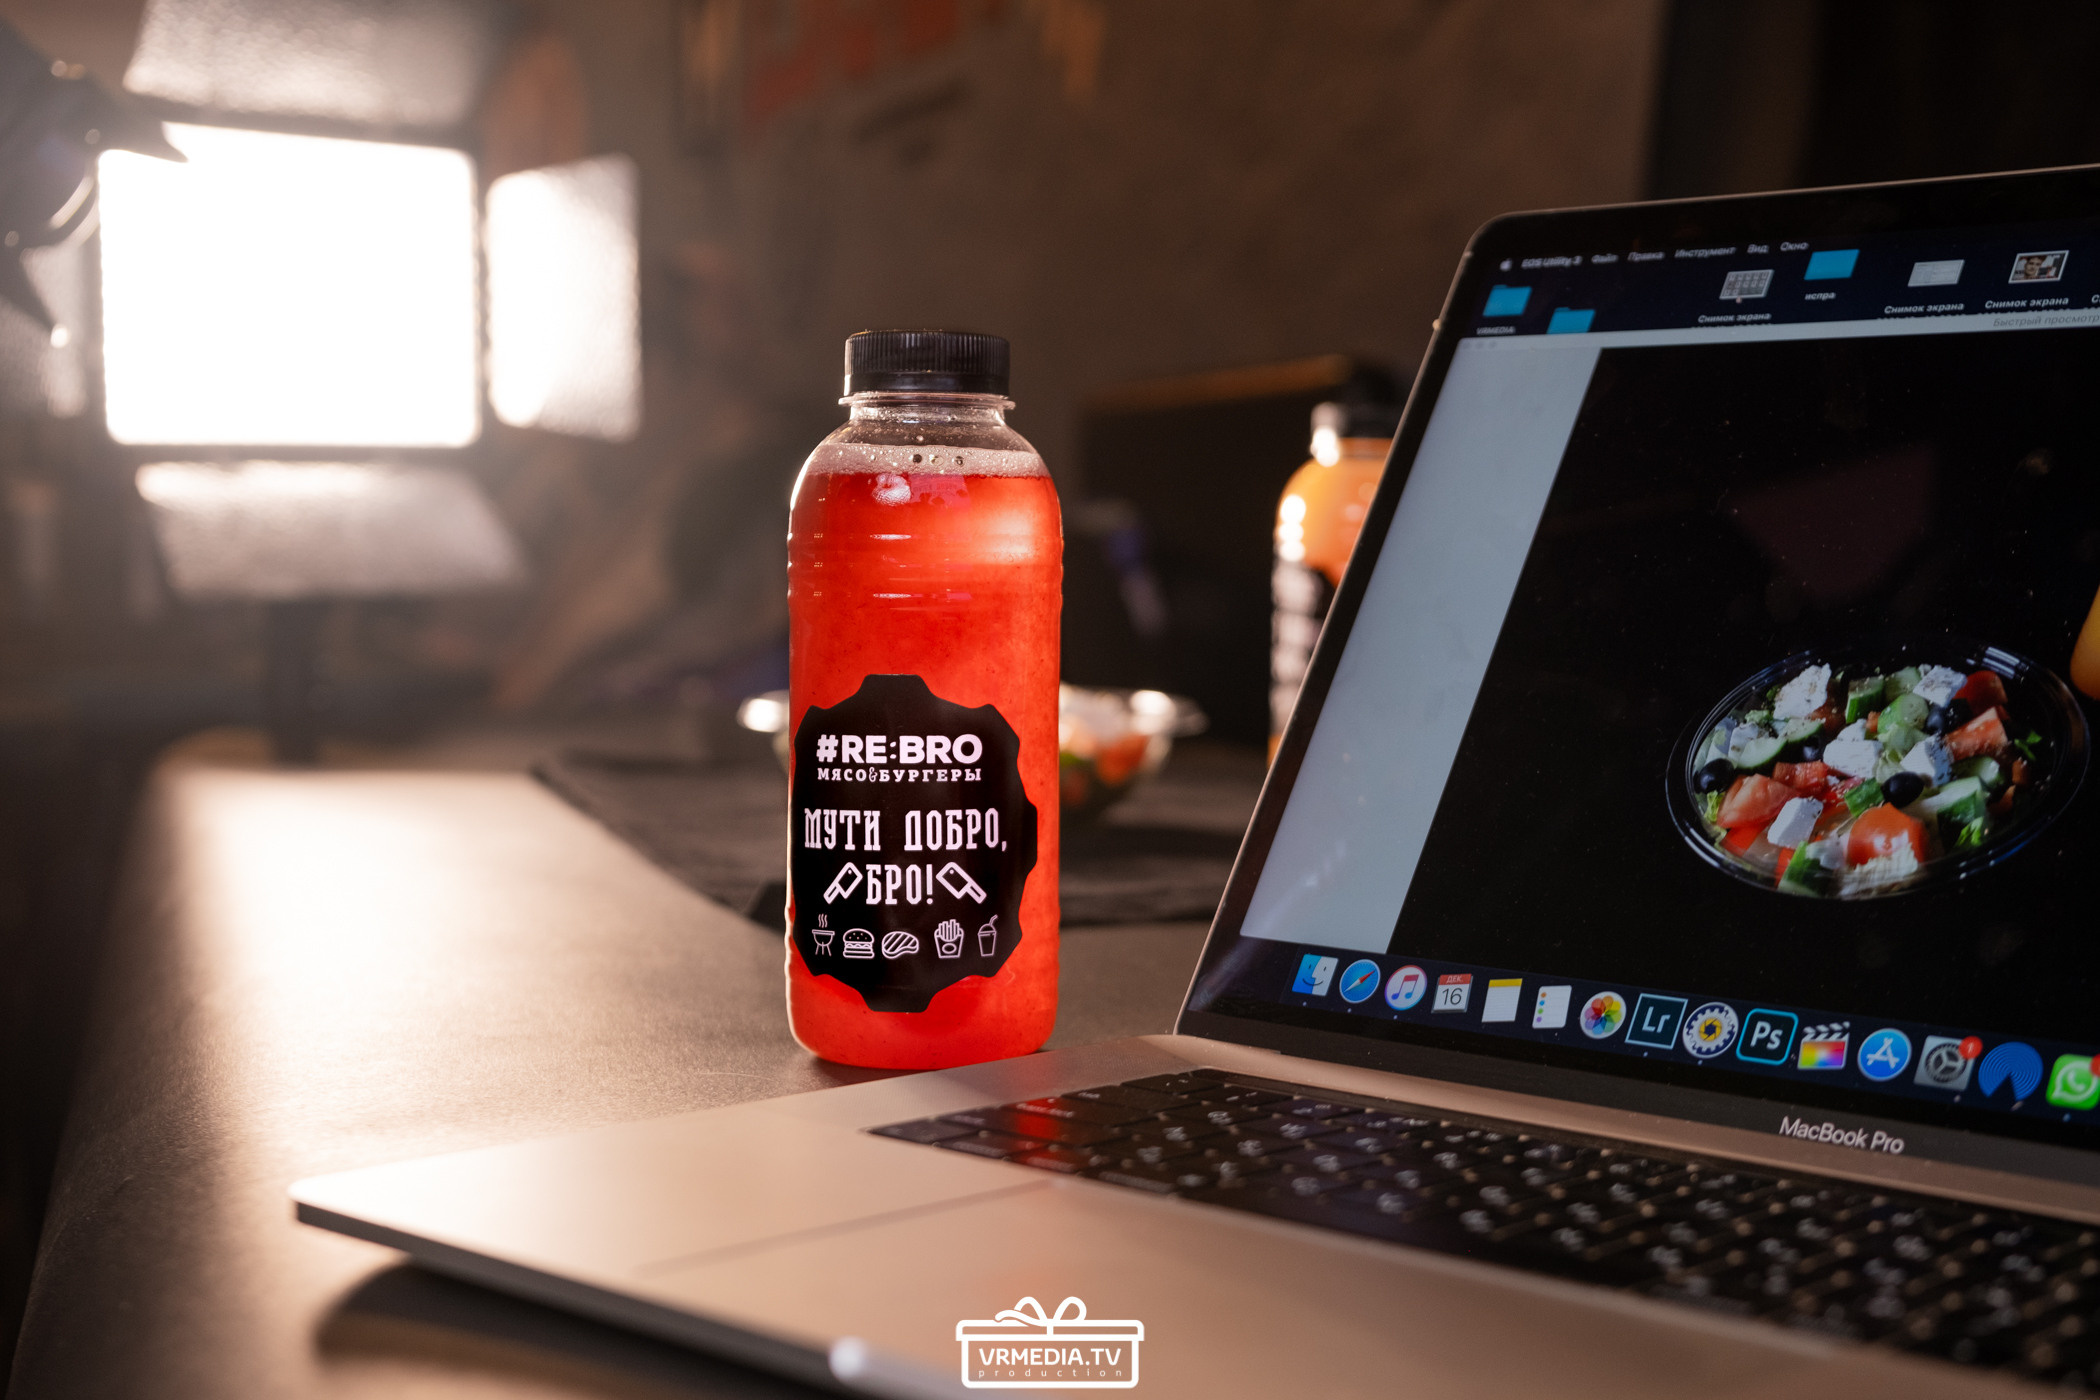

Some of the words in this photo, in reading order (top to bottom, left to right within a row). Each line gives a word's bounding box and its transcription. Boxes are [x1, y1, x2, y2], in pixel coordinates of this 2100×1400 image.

[1627, 251, 1665, 262] Правка
[1674, 246, 1737, 259] Инструмент
[1747, 243, 1769, 254] Вид
[1780, 241, 1809, 251] Окно
[1805, 291, 1836, 301] испра
[1984, 299, 2027, 309] Снимок
[2029, 297, 2070, 307] экрана
[1698, 314, 1735, 324] Снимок
[1736, 312, 1772, 323] экрана
[1884, 305, 1925, 315] Снимок
[1926, 303, 1965, 313] экрана
[1993, 315, 2042, 328] Быстрый
[816, 733, 983, 764] #RE:BRO
[817, 766, 982, 782] МЯСО&БУРГЕРЫ
[804, 807, 881, 851] МУТИ
[904, 807, 1007, 852] ДОБРО,
[865, 863, 934, 905] БРО!
[1442, 987, 1463, 1006] 16
[1642, 1006, 1671, 1033] Lr
[1750, 1020, 1783, 1050] Ps
[1778, 1115, 1869, 1149] MacBook
[1869, 1130, 1905, 1155] Pro
